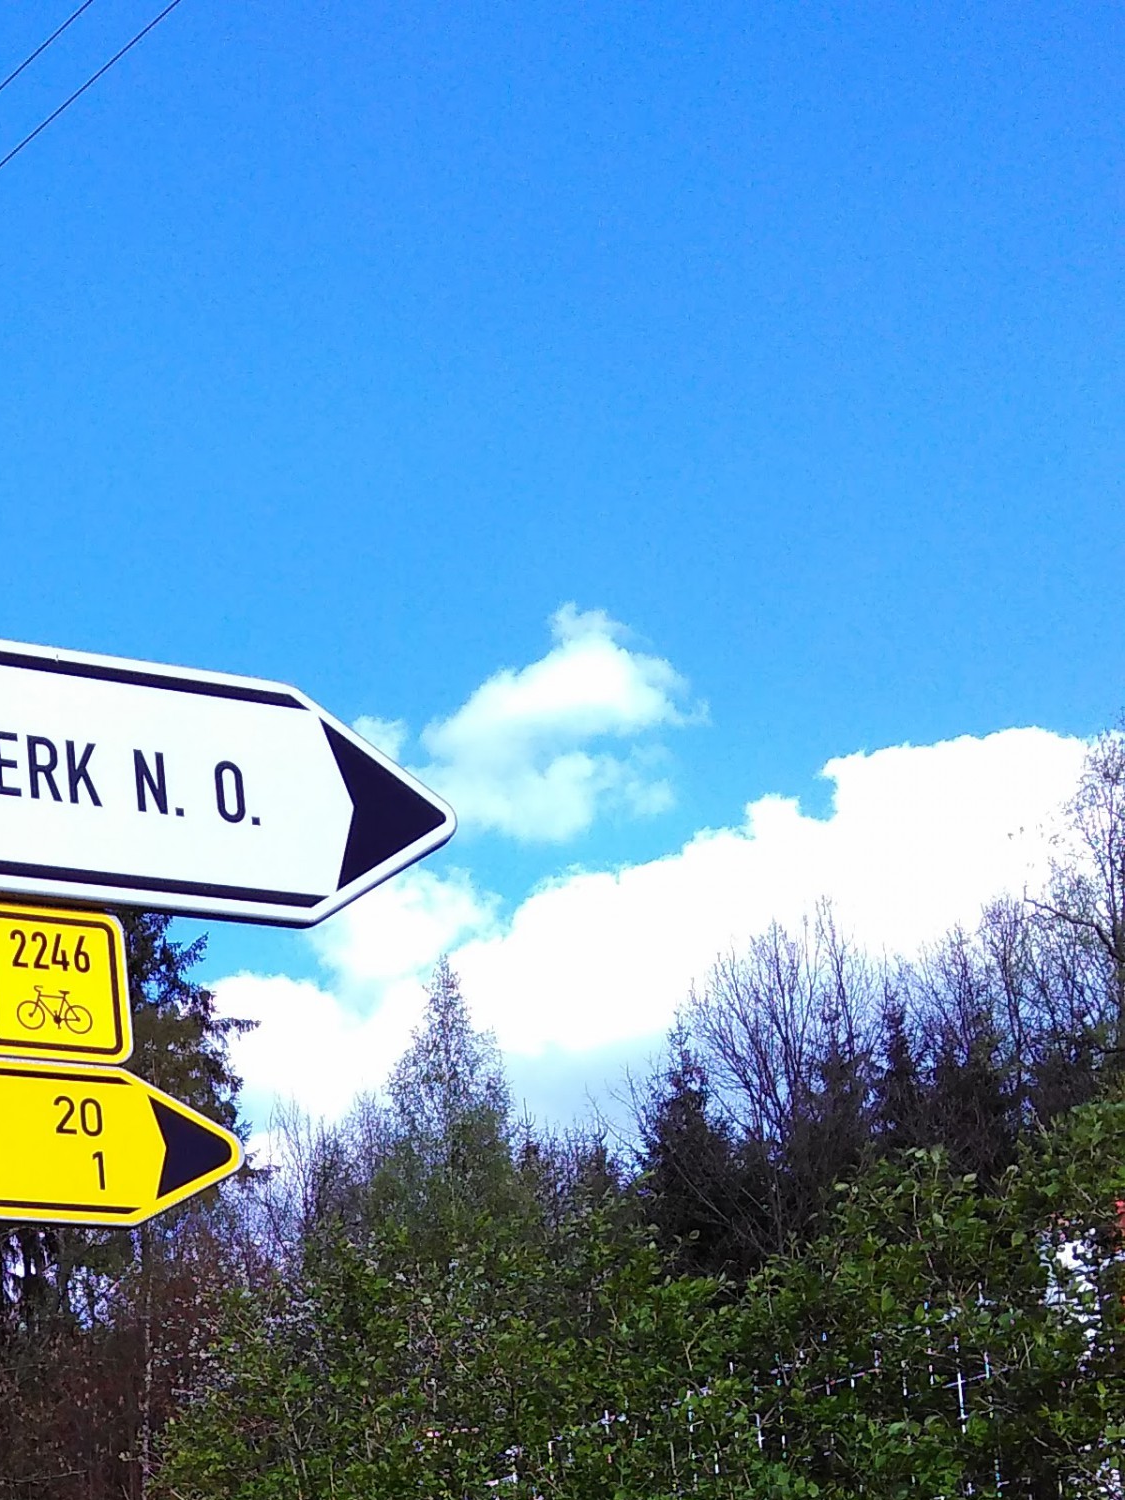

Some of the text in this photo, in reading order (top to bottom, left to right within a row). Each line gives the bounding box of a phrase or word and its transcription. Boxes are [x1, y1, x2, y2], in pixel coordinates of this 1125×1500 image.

[133, 748, 185, 817] N.
[213, 760, 261, 826] O.
[10, 929, 91, 973] 2246
[53, 1095, 103, 1137] 20
[92, 1151, 107, 1191] 1
